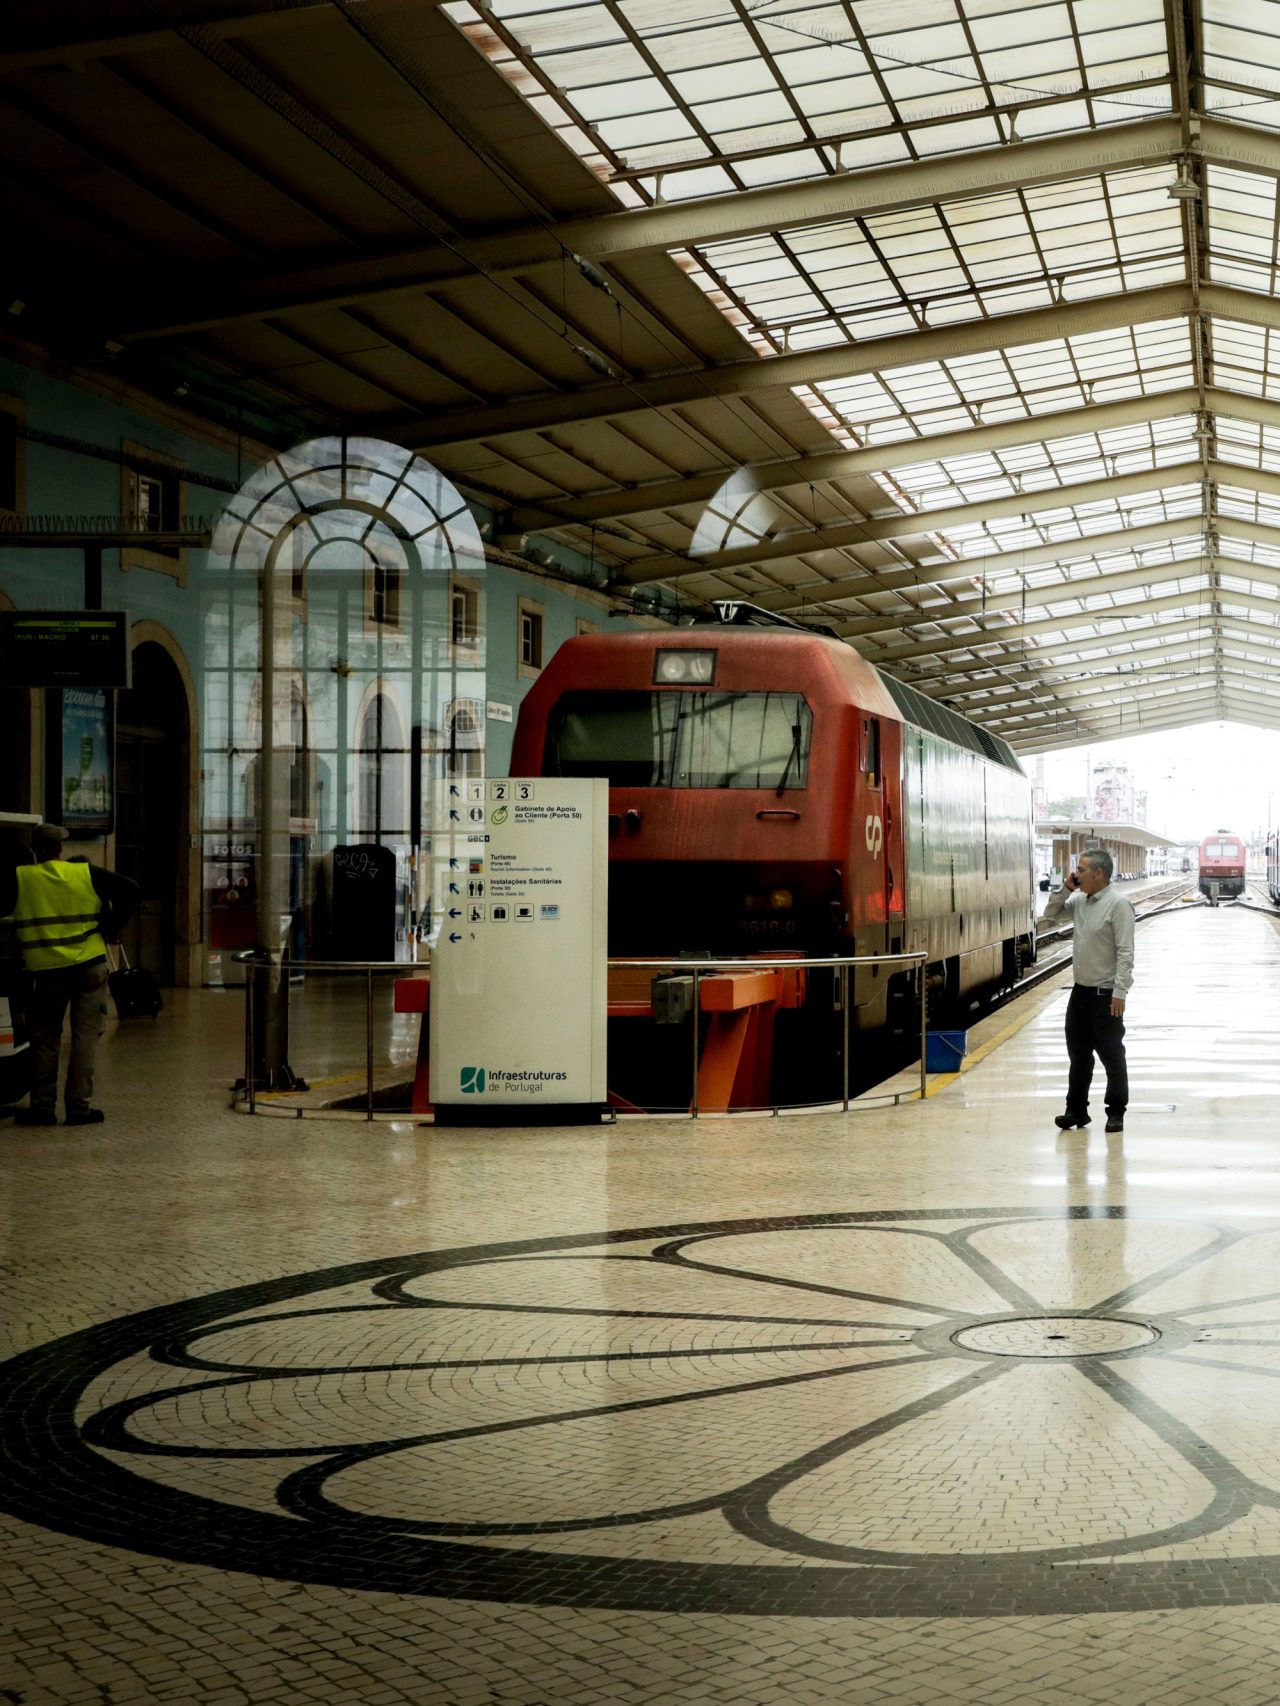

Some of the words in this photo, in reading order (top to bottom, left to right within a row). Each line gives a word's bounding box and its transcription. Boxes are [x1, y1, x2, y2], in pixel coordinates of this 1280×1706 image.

[474, 788, 480, 799] 1
[496, 787, 505, 799] 2
[520, 787, 529, 799] 3
[549, 812, 570, 820] (Porta
[214, 845, 252, 855] FOTOS
[488, 1070, 567, 1081] Infraestruturas
[488, 1082, 500, 1092] de
[504, 1082, 543, 1093] Portugal
